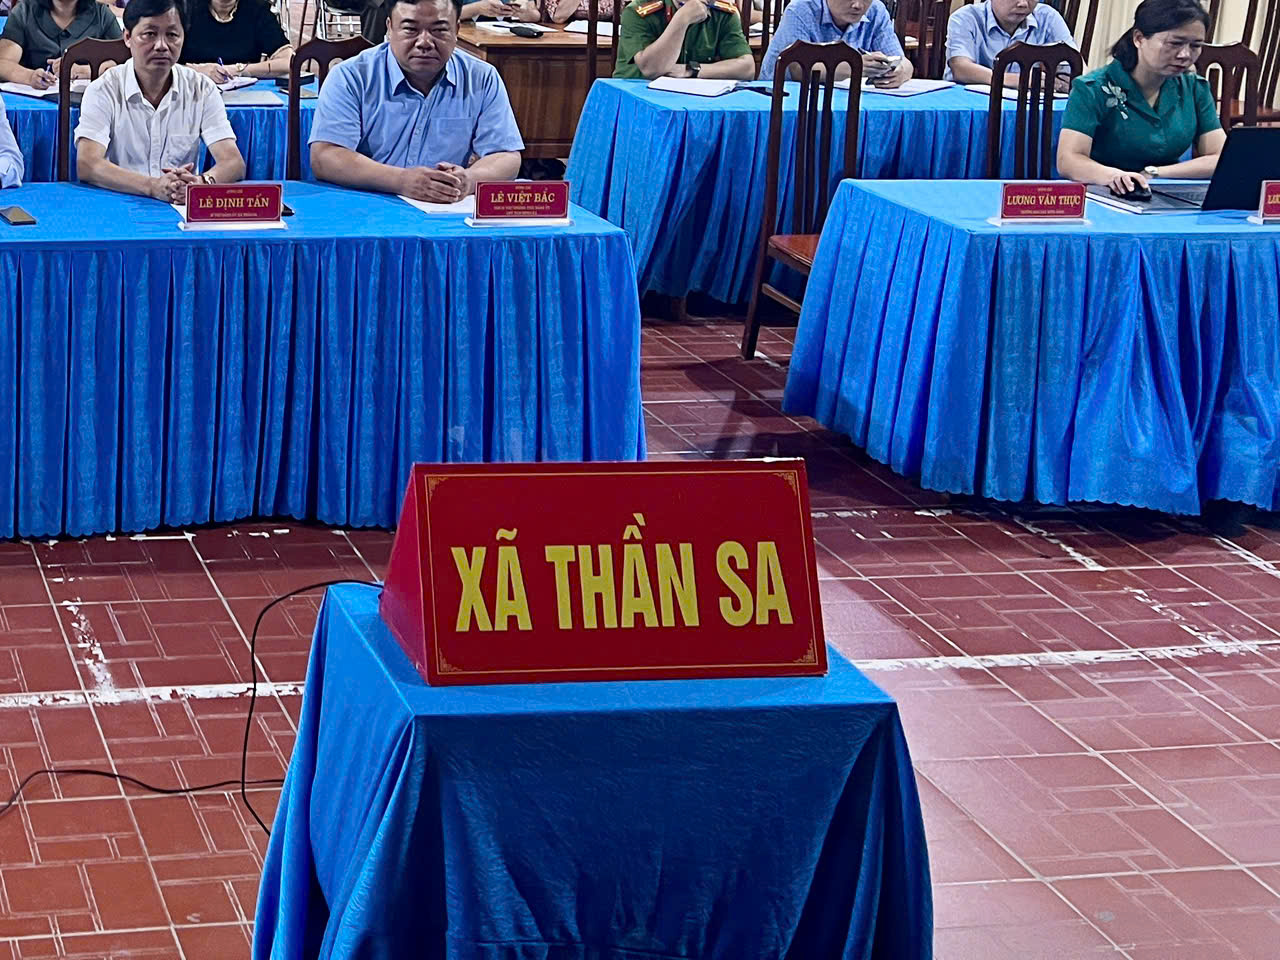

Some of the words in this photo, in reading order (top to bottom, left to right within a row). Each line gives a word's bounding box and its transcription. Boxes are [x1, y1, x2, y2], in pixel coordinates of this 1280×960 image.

[199, 195, 213, 208] LÊ
[490, 190, 505, 203] LÊ
[507, 190, 532, 206] VIỆT
[450, 528, 533, 632] XÃ
[545, 512, 700, 631] THẦN
[716, 540, 794, 627] SA
